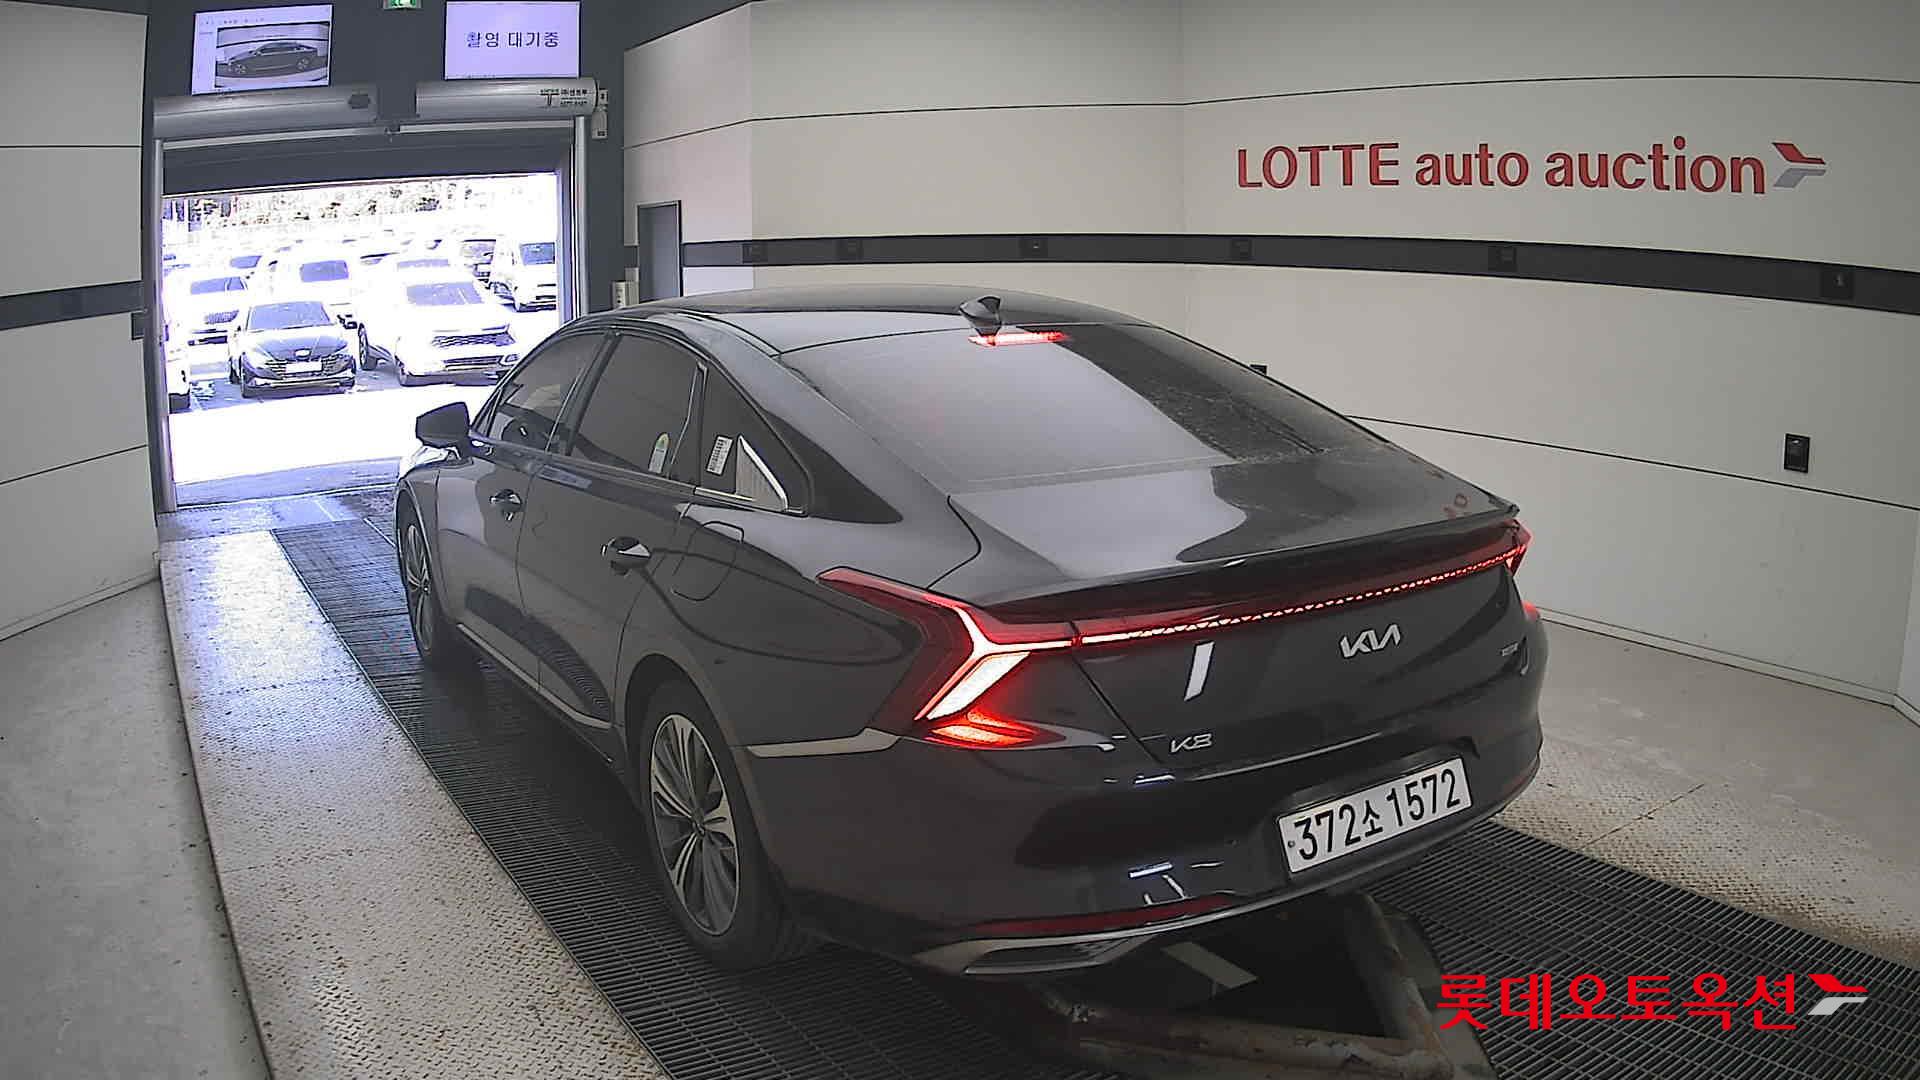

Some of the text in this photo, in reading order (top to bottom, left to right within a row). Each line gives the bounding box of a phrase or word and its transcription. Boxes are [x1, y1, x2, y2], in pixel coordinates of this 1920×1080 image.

[508, 31, 559, 48] 대기중
[1238, 136, 1766, 194] LOTTE auto auction
[1170, 733, 1212, 753] K8
